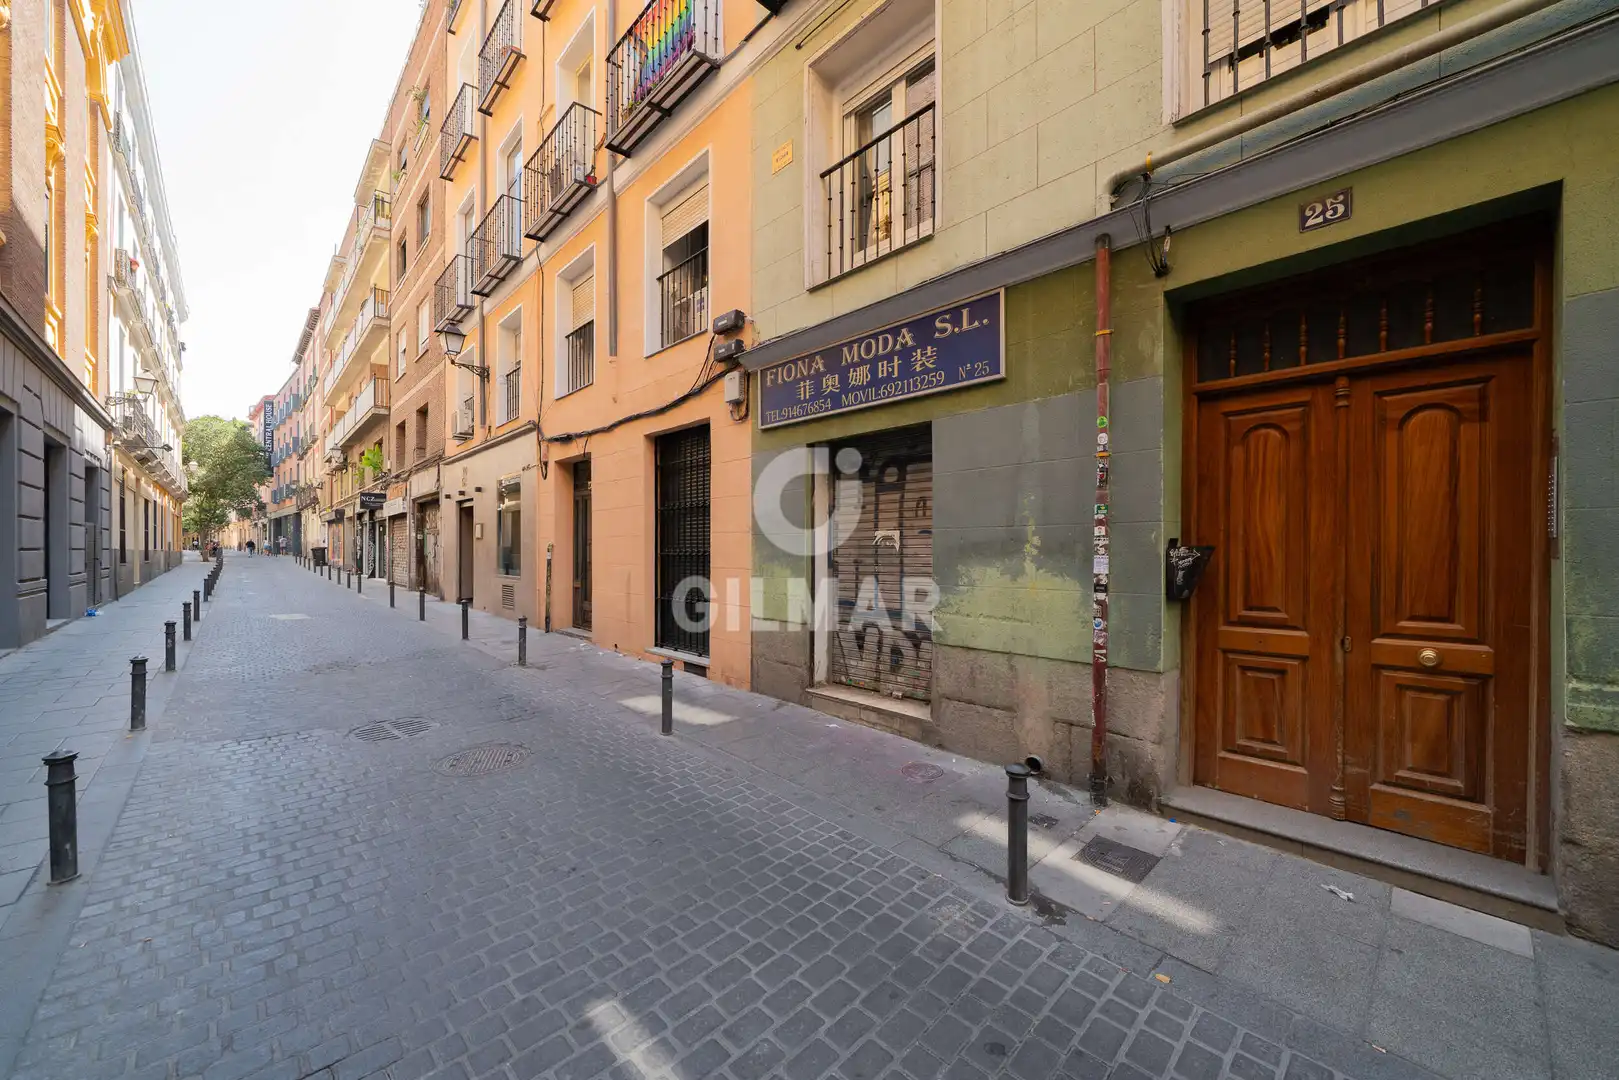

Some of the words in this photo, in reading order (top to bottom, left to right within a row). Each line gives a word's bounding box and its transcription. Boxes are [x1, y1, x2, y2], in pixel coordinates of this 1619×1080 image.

[1304, 194, 1346, 227] 25
[766, 354, 826, 387] FIONA
[841, 327, 917, 367] MODA
[933, 307, 990, 339] S.L.
[795, 345, 938, 401] 菲奥娜时装
[841, 370, 945, 407] MOVIL:692113259
[974, 360, 990, 378] 25
[265, 403, 273, 424] HOUSE
